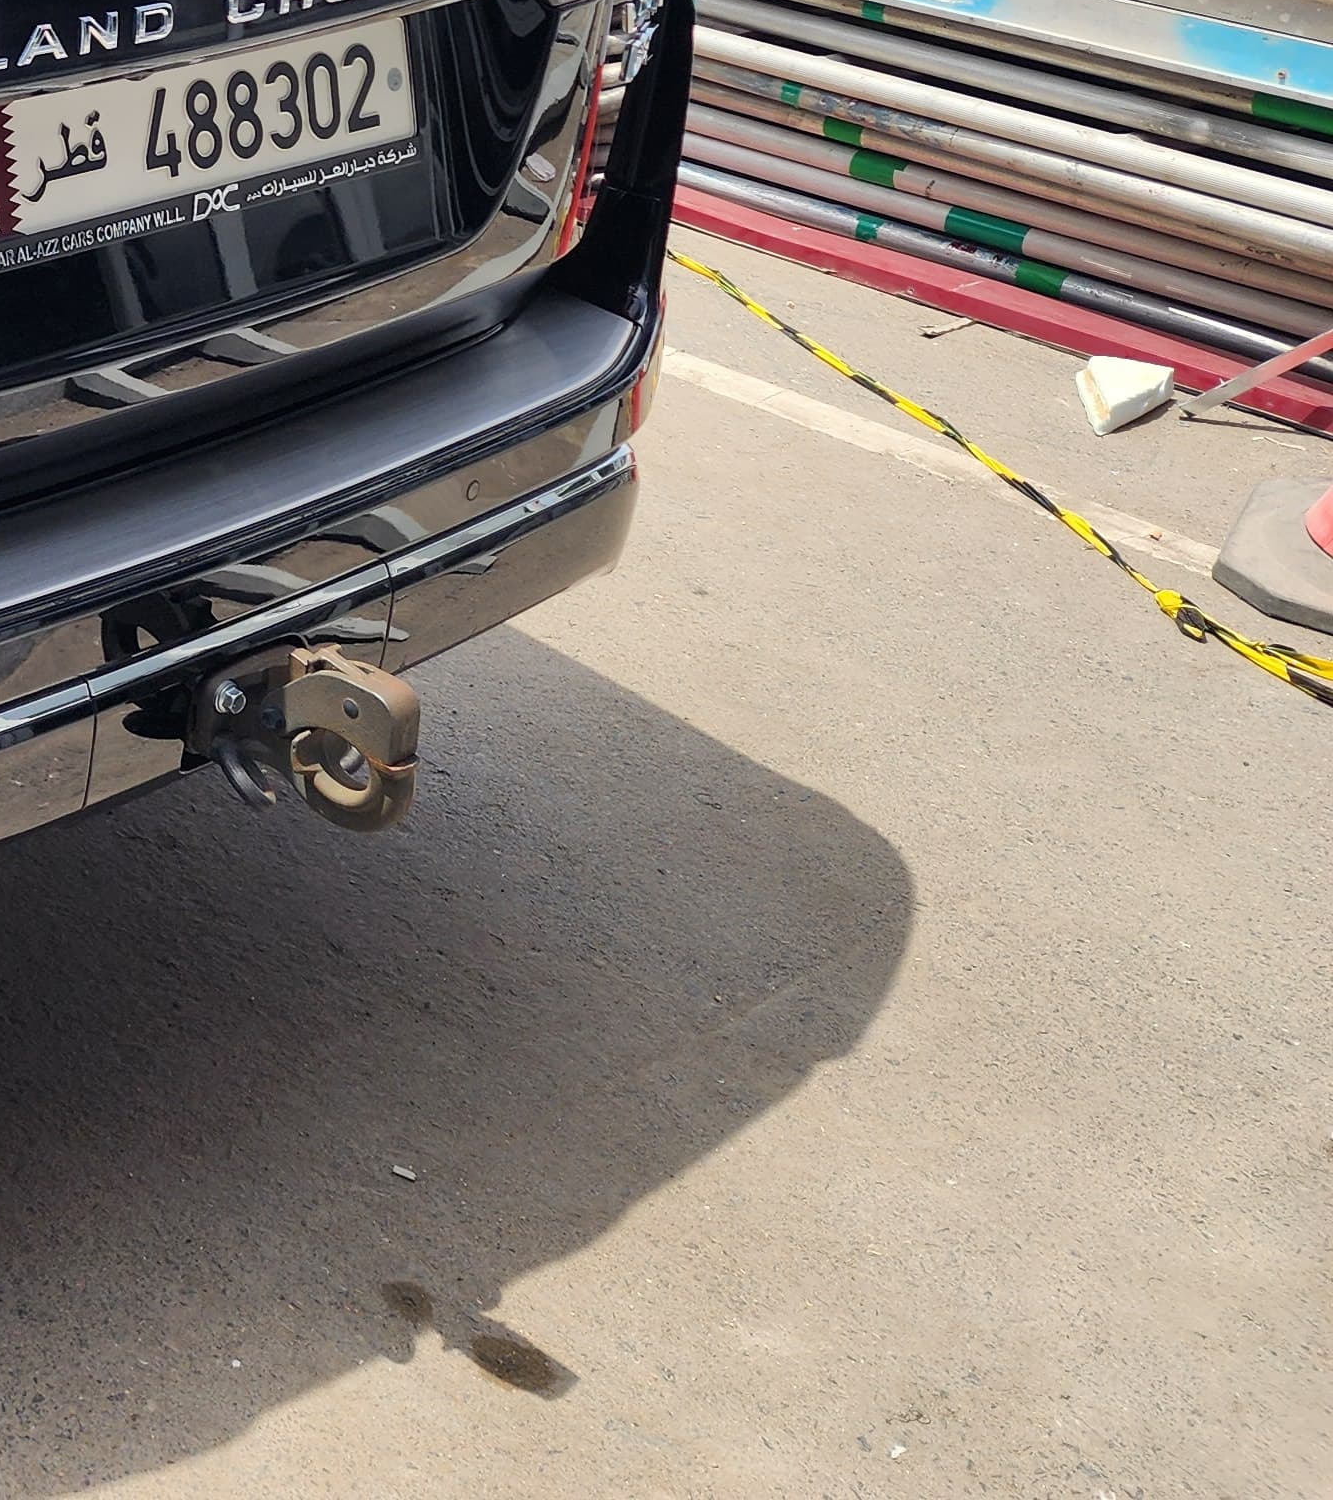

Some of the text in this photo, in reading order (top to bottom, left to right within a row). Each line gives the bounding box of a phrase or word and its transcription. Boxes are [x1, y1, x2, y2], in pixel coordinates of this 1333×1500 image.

[145, 43, 381, 177] 488302
[20, 110, 108, 203] قطر
[377, 142, 418, 165] شركة
[261, 169, 317, 198] للسيارات
[17, 238, 60, 264] AL-AZZ
[61, 231, 95, 252] CARS
[96, 214, 152, 241] COMPANY
[153, 207, 186, 228] W.L.L.
